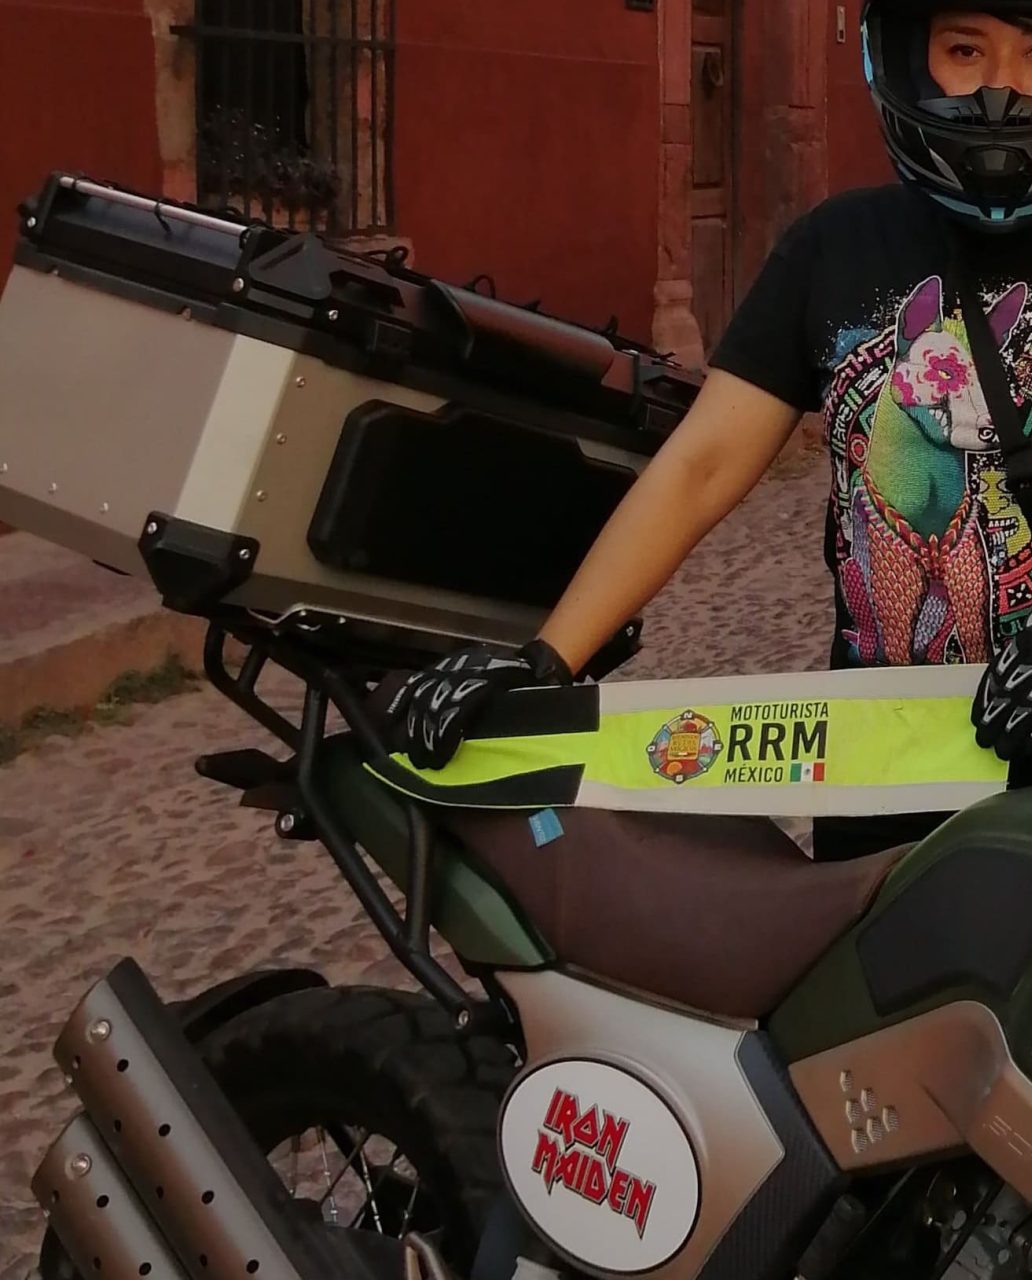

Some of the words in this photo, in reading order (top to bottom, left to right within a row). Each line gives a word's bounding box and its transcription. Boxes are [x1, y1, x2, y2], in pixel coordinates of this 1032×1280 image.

[730, 702, 829, 722] MOTOTURISTA
[727, 720, 828, 762] RRM
[724, 764, 784, 783] MÉXICO
[543, 1086, 631, 1176] IRON
[531, 1128, 657, 1240] MAIDEN
